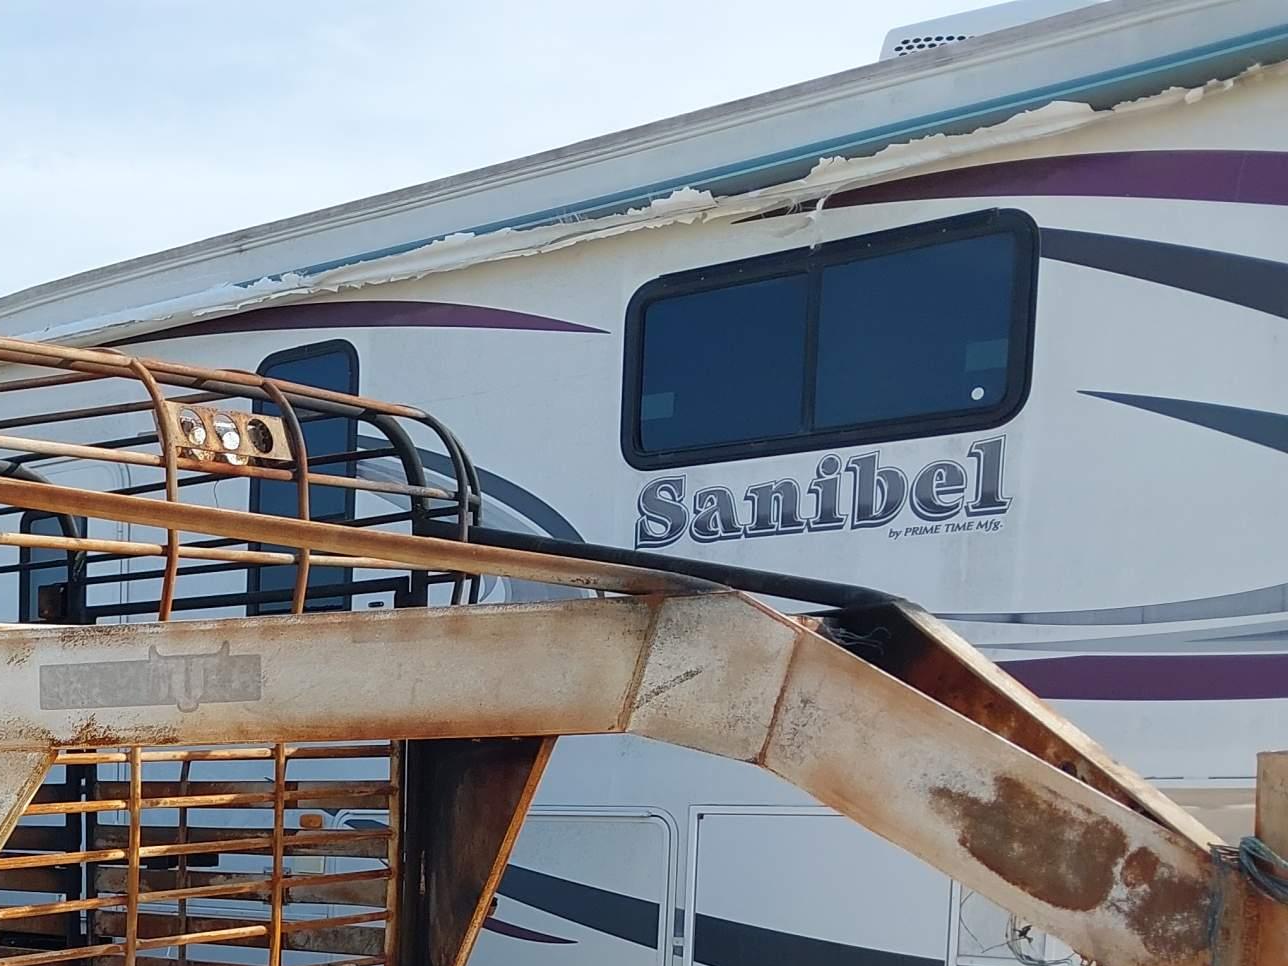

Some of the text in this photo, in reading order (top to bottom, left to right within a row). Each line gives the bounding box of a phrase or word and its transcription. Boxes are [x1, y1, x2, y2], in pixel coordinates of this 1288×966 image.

[634, 434, 1014, 550] Sanibel
[888, 519, 1003, 540] by PRIME TIME Mfg.
